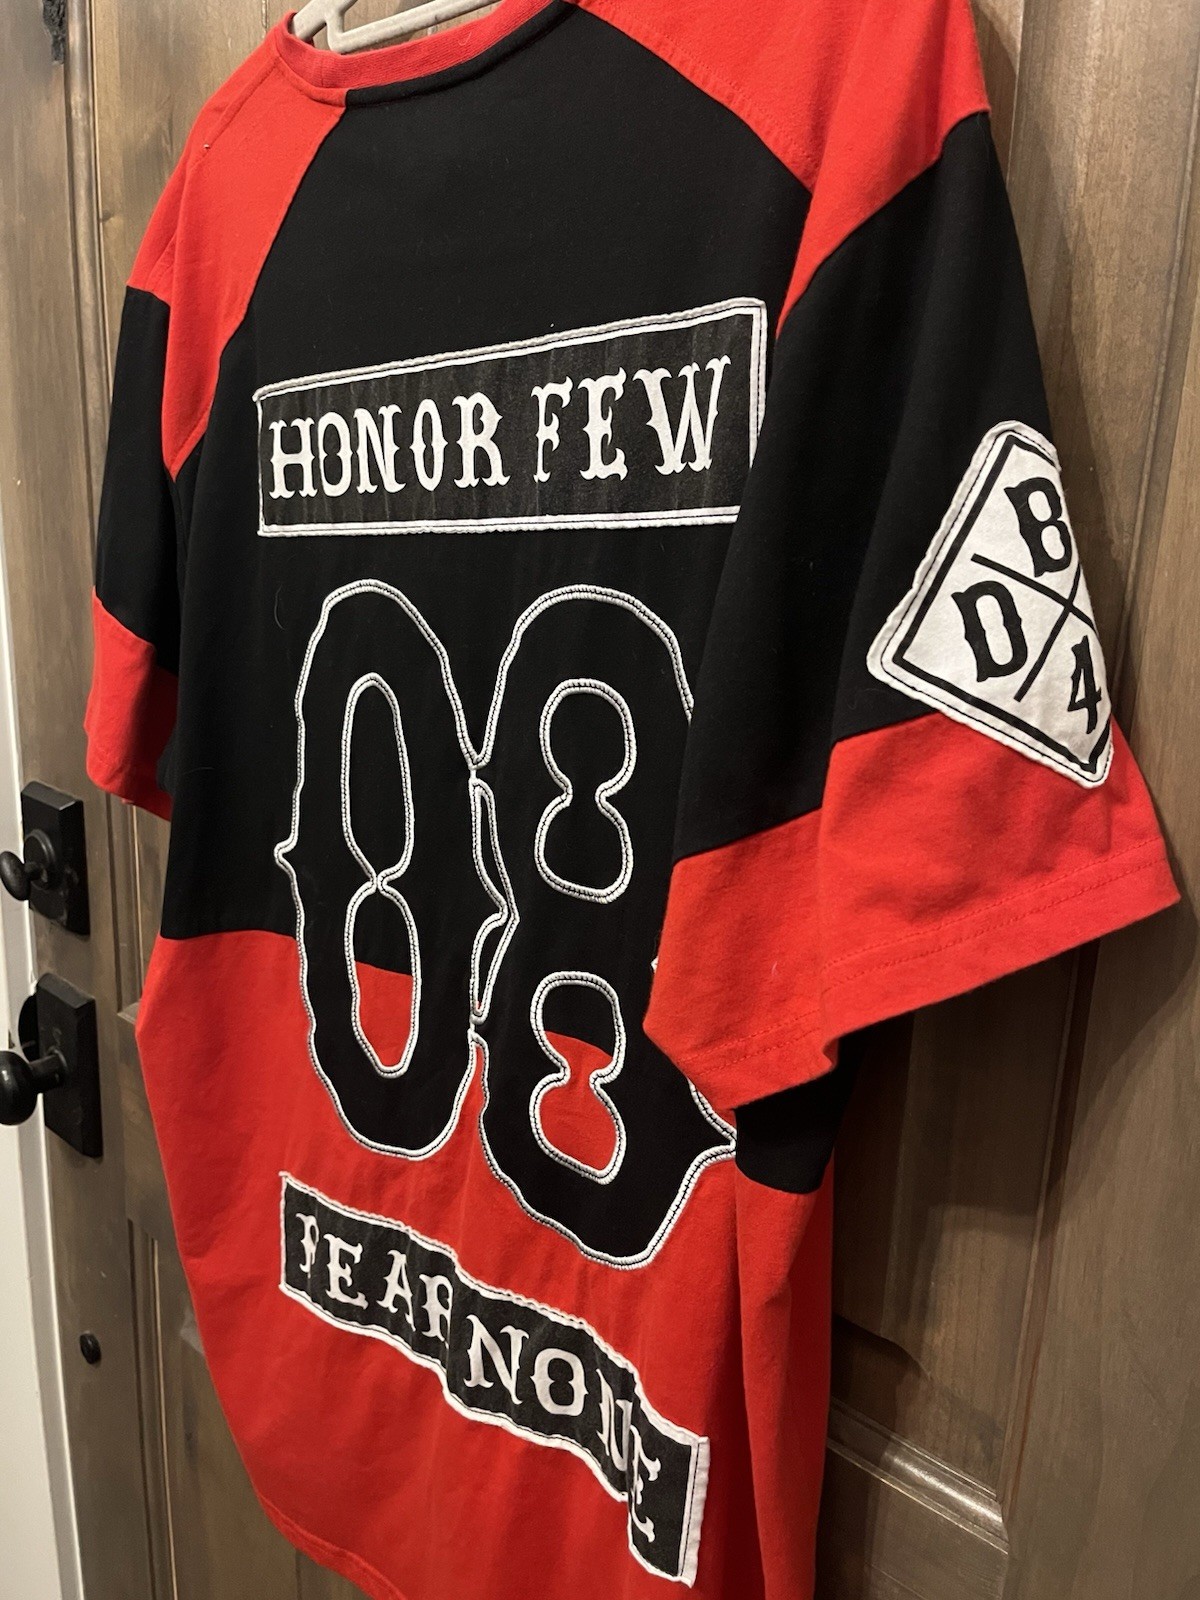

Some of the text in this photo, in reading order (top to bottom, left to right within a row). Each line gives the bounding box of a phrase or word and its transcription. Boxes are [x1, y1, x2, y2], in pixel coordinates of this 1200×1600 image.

[269, 355, 731, 499] HONOR FEW
[1004, 477, 1072, 577] B
[951, 580, 1028, 682] D
[1067, 635, 1102, 734] 4
